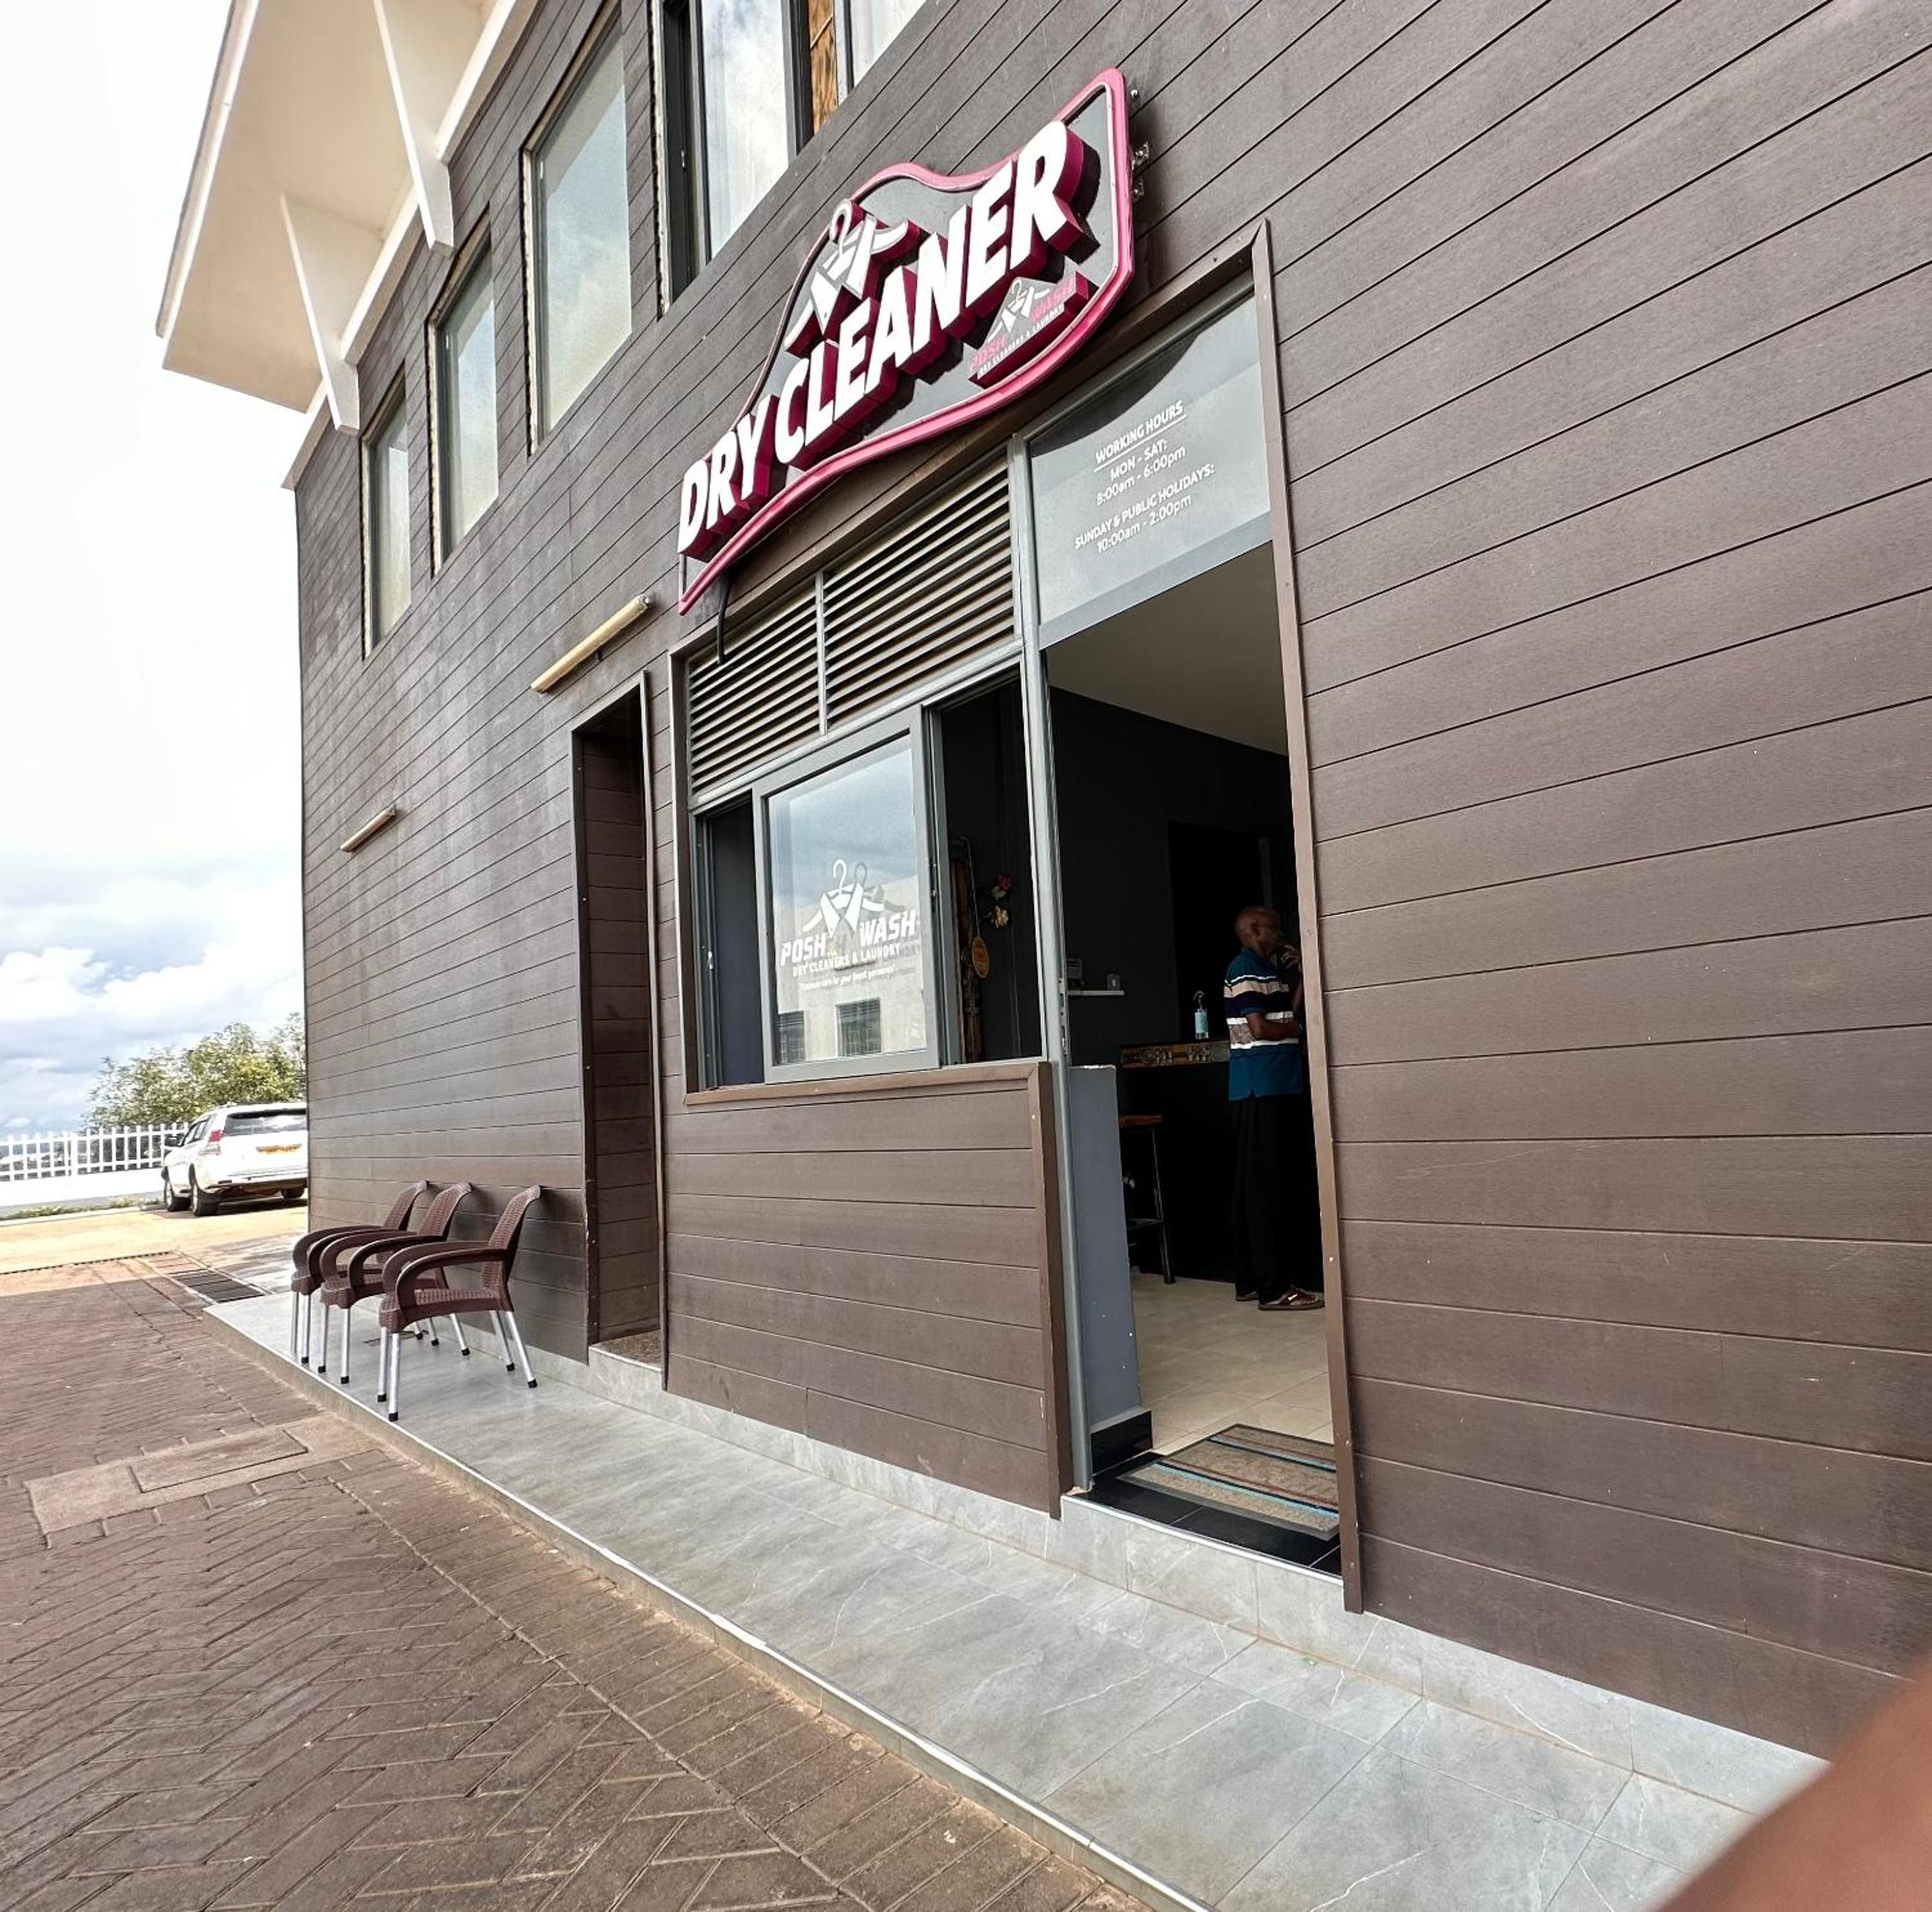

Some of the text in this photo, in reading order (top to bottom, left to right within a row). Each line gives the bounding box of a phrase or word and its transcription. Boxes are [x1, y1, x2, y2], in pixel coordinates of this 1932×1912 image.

[677, 120, 1070, 554] DRY CLEANER
[968, 335, 1005, 374] POSH
[1096, 400, 1183, 464] WORKING HOURS
[1110, 457, 1136, 481] MON
[1144, 439, 1168, 461] SAT:
[1096, 476, 1135, 505] 8:00am
[1144, 446, 1186, 478] 6:00pm
[1075, 464, 1214, 549] SUNDAY & PUBLIC HOLIDAYS:
[1097, 523, 1140, 553] 10:00am
[1149, 495, 1191, 526] 2:00pm
[780, 909, 916, 966] POSH WASH
[793, 963, 807, 977] DRY
[861, 942, 900, 962] LAUNDRY
